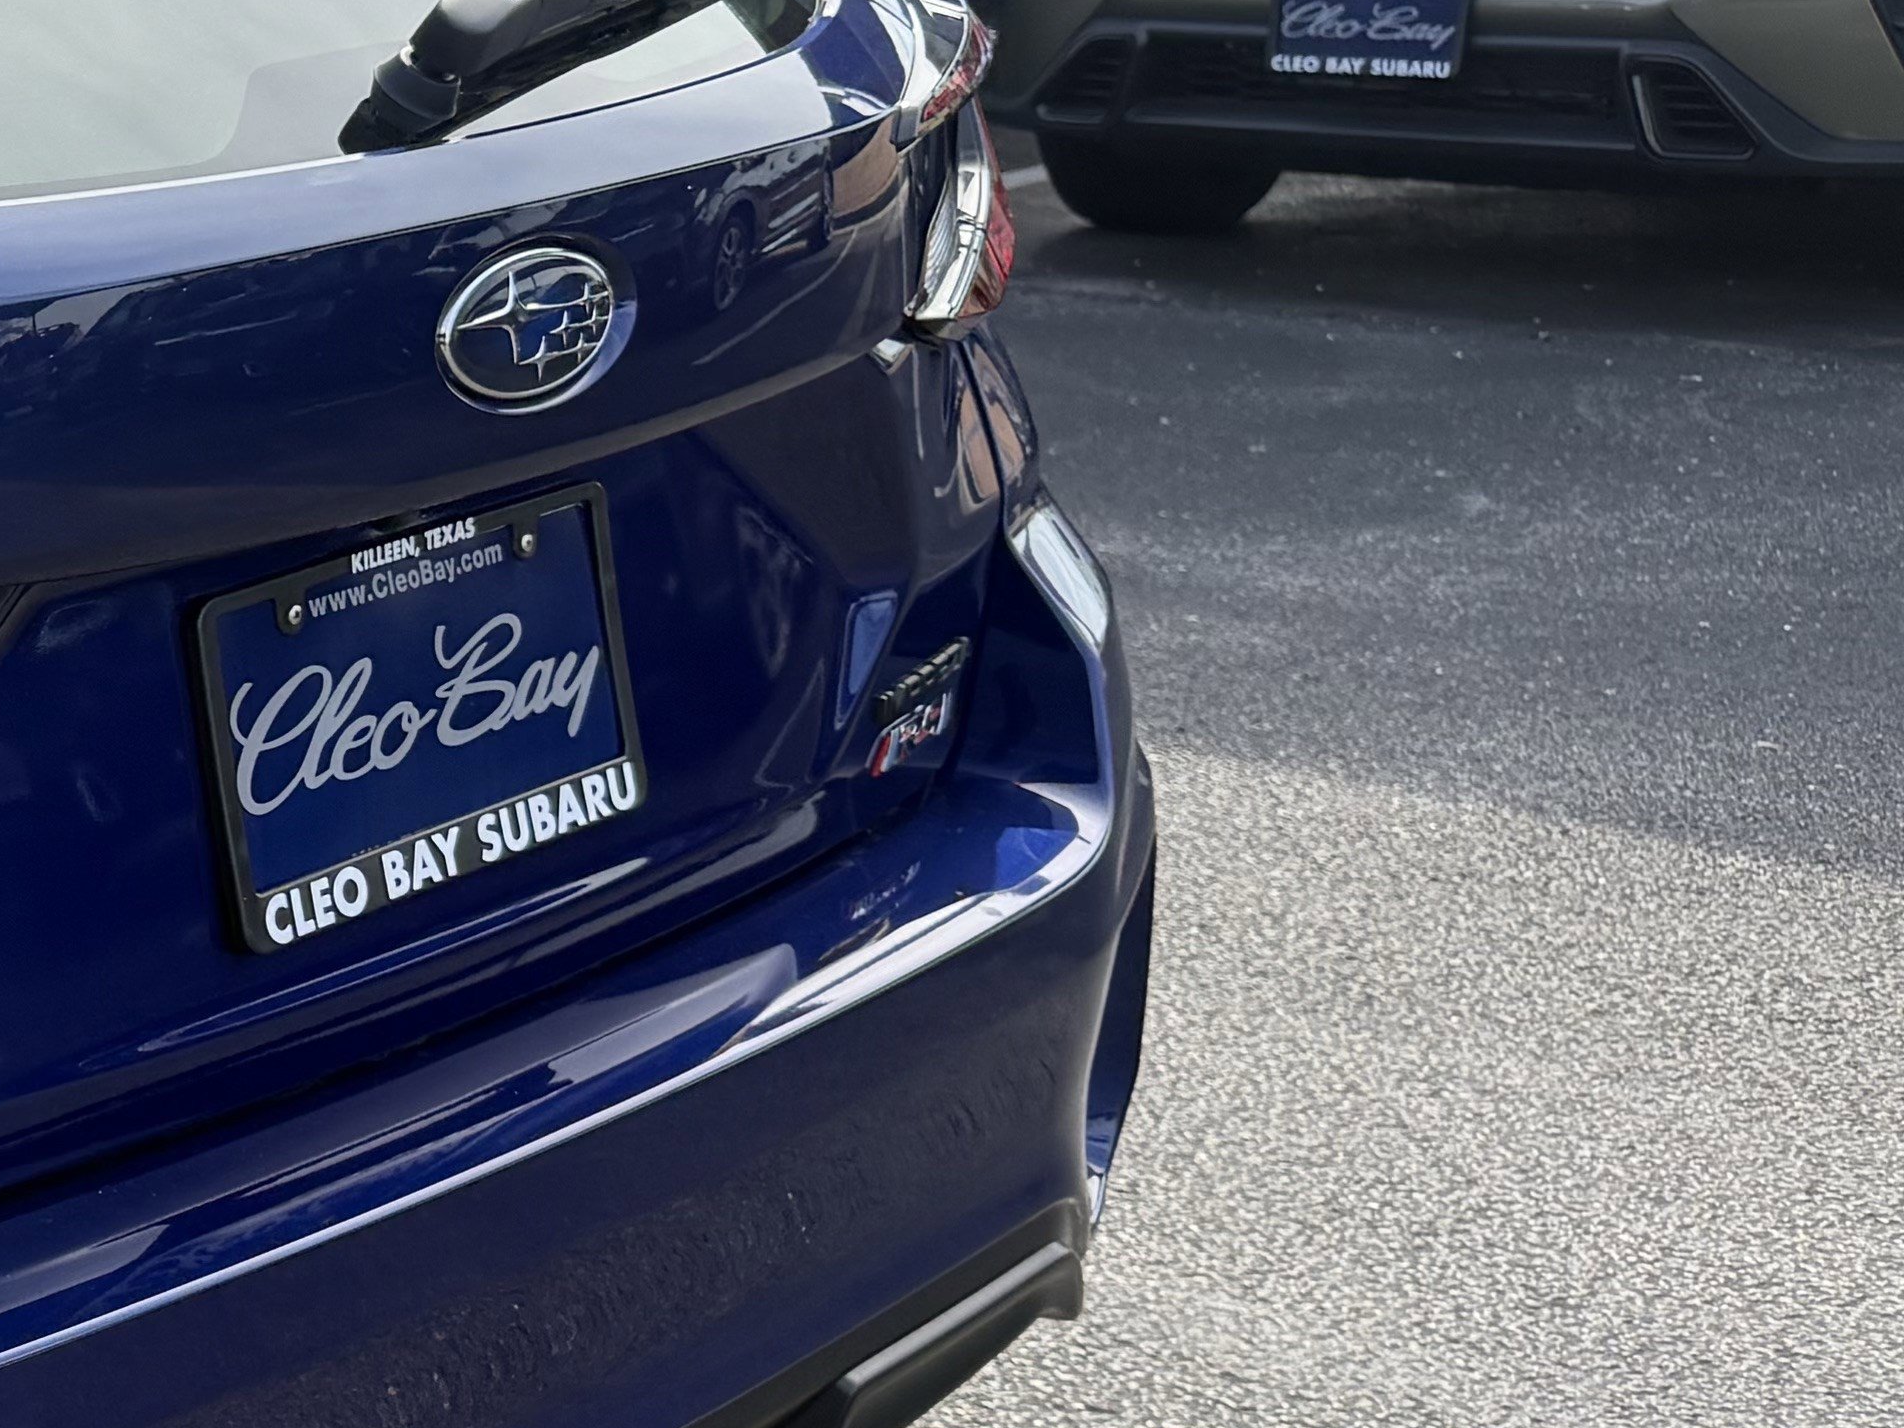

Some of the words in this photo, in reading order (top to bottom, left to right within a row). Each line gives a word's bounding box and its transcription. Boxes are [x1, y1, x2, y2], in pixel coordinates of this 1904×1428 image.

[1282, 0, 1367, 38] Cleo
[1367, 2, 1455, 50] Bay
[1271, 53, 1321, 73] CLEO
[1325, 56, 1367, 75] BAY
[1370, 57, 1452, 79] SUBARU
[351, 536, 420, 574] KILLEEN,
[424, 517, 476, 551] TEXAS
[308, 543, 503, 618] www.CleoBay.com
[230, 657, 436, 815] Cleo
[433, 613, 599, 747] Bay
[265, 866, 368, 945] CLEO
[381, 827, 461, 900] BAY
[476, 761, 637, 863] SUBARU
